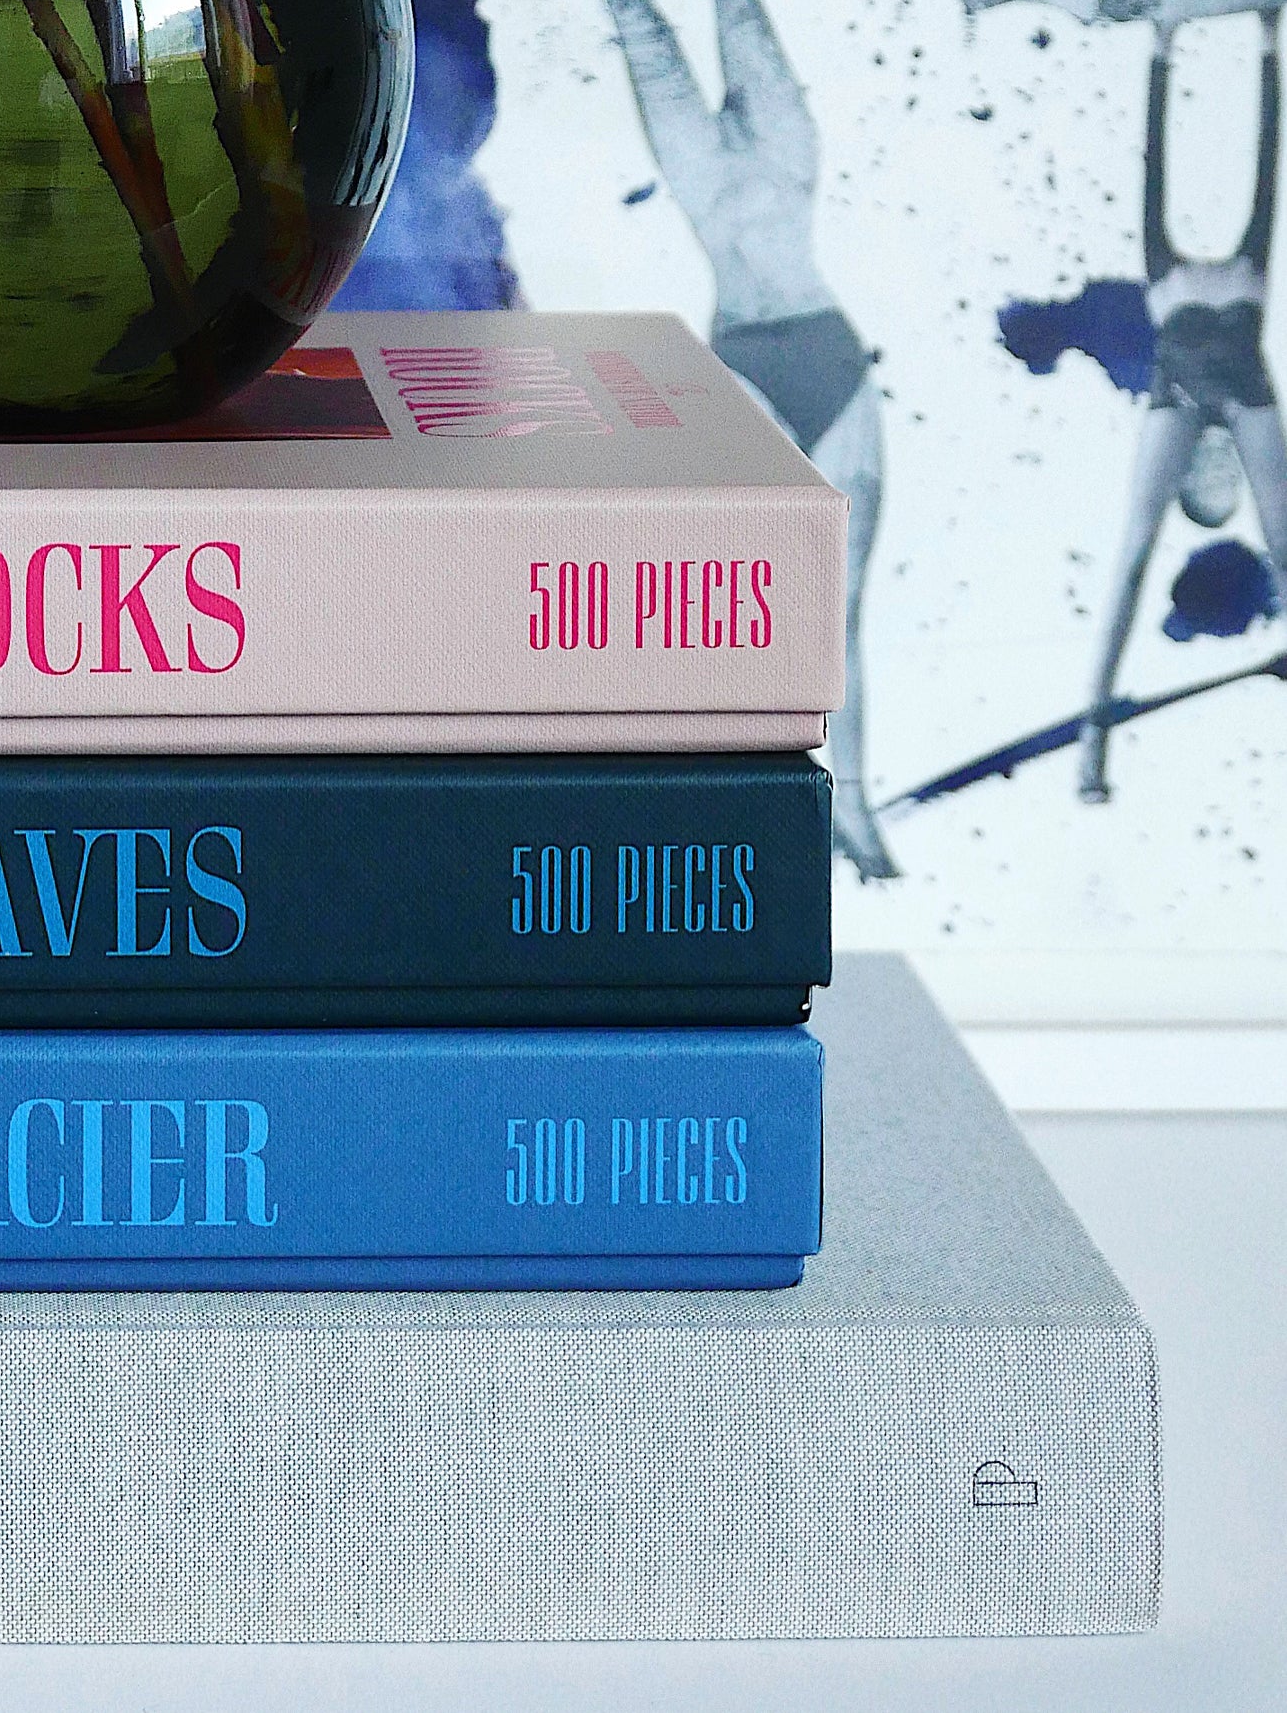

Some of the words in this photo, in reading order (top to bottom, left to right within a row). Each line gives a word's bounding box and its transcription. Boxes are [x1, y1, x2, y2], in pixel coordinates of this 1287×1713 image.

[530, 562, 608, 649] 500
[636, 561, 771, 648] PIECES
[513, 846, 590, 933] 500
[618, 845, 753, 932] PIECES
[507, 1118, 585, 1206] 500
[612, 1117, 747, 1204] PIECES
